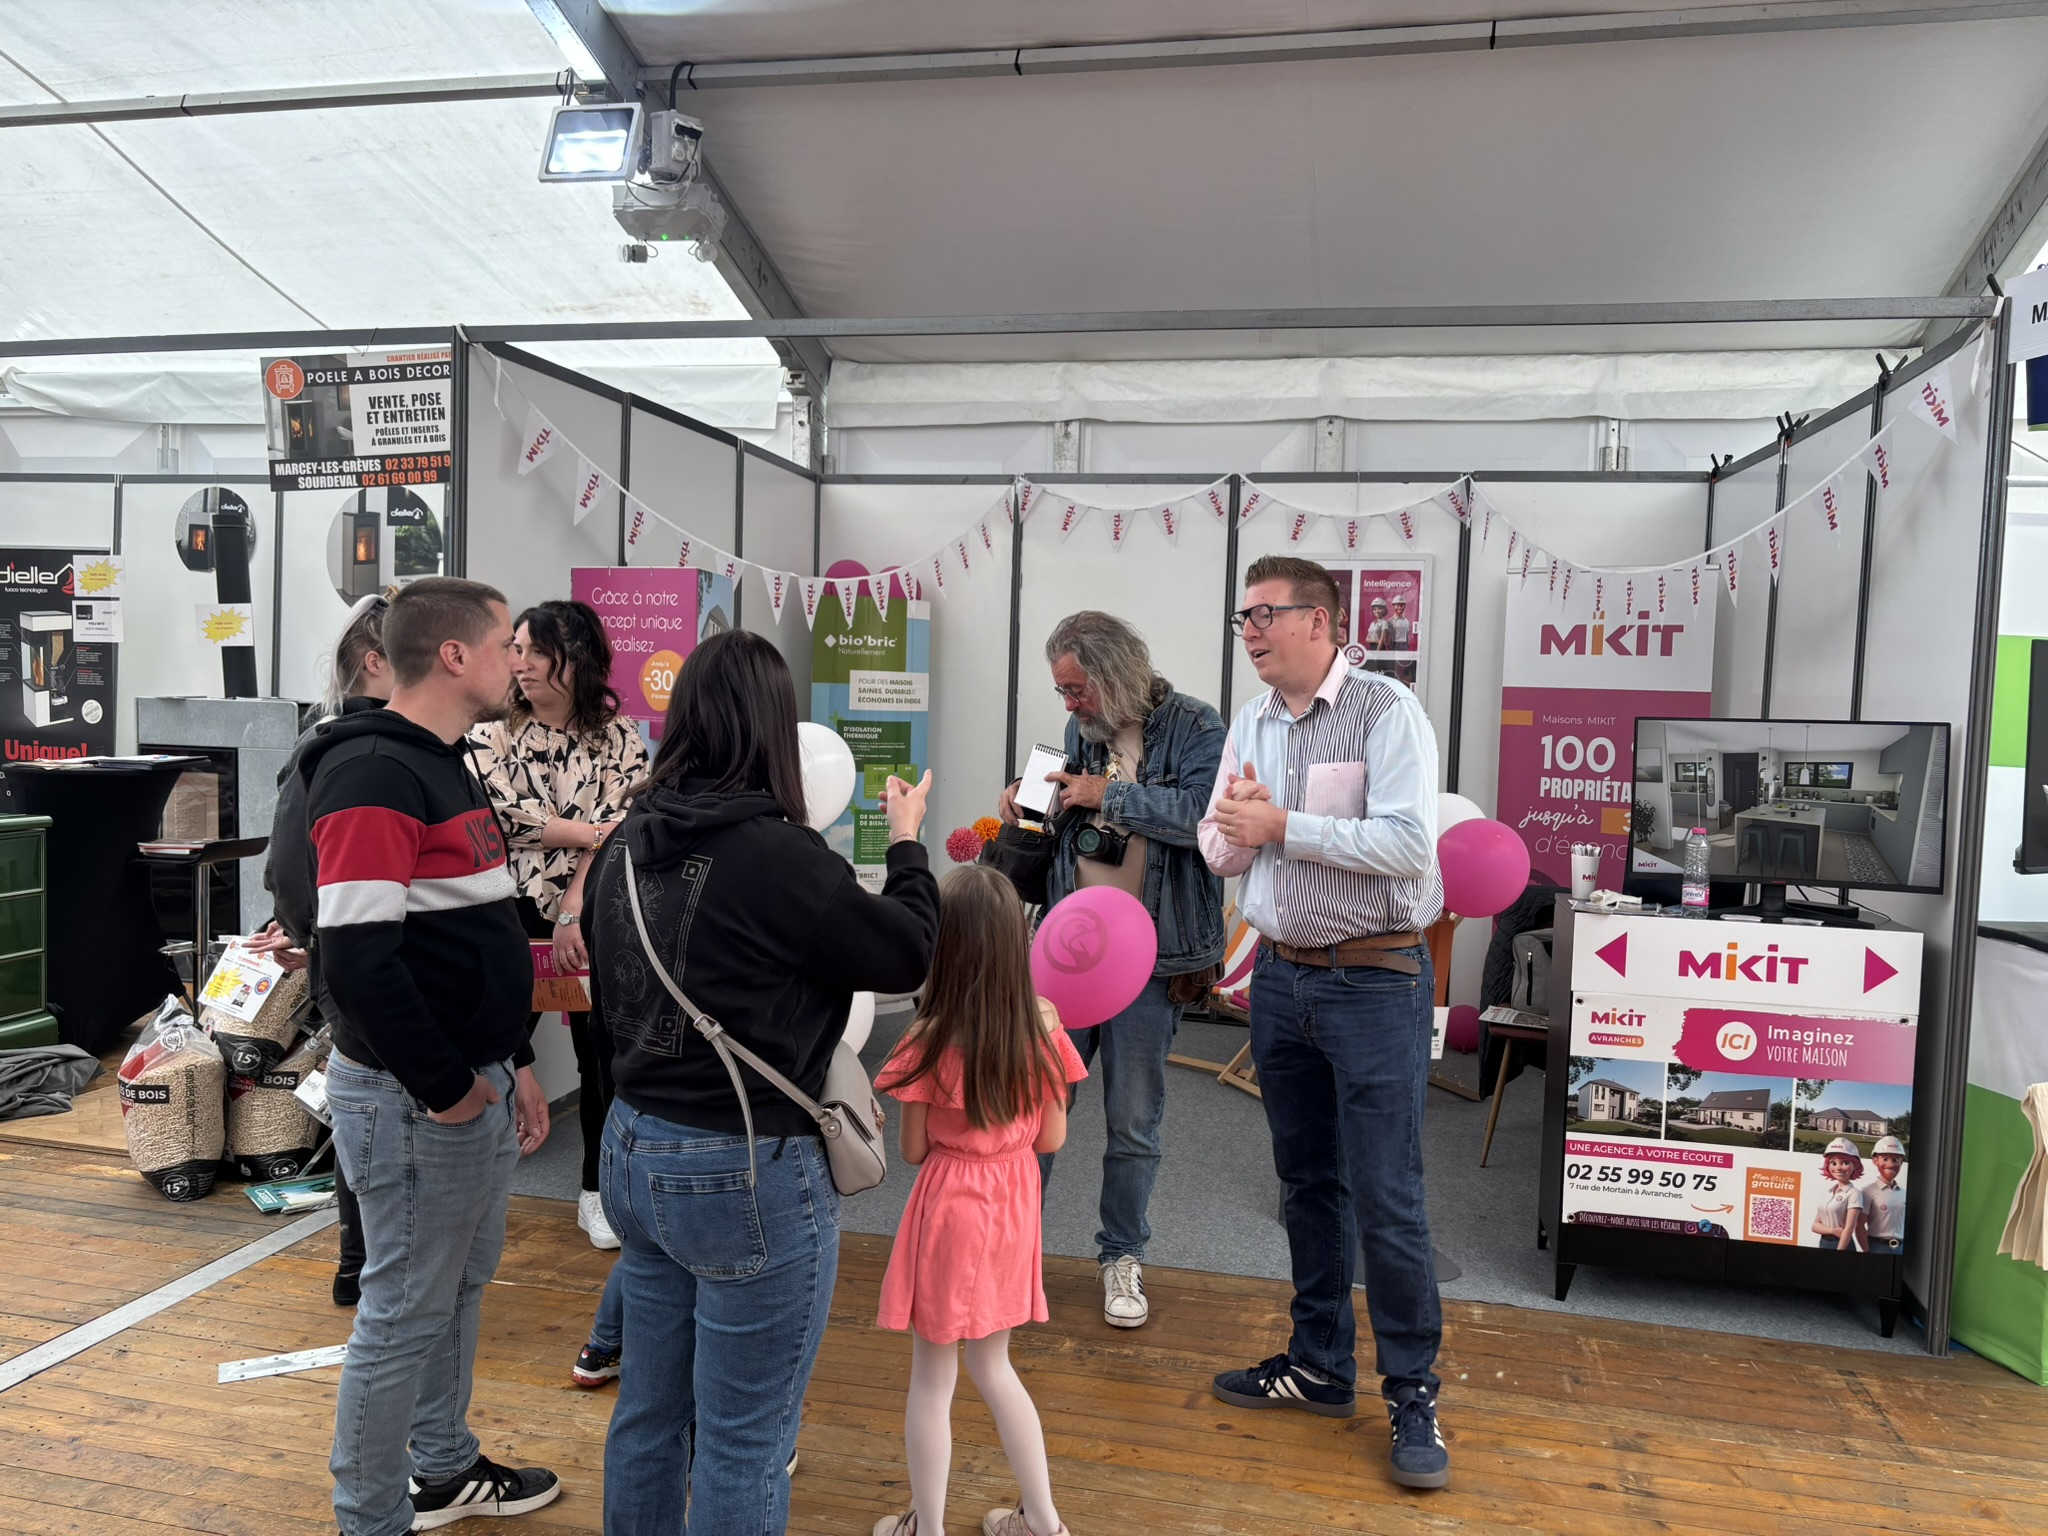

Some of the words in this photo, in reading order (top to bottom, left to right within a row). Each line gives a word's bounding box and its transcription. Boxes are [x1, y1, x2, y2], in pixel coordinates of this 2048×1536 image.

[386, 353, 416, 363] CHANTIER
[416, 350, 440, 360] RÉALISÉ
[306, 370, 348, 385] POELE
[354, 369, 364, 382] A
[369, 366, 401, 381] BOIS
[406, 364, 450, 378] DECOR
[368, 394, 409, 410] VENTE,
[411, 392, 442, 407] POSE
[366, 411, 382, 425] ET
[383, 407, 446, 424] ENTRETIEN
[401, 426, 409, 435] ET
[410, 424, 440, 435] INSERTS
[371, 436, 377, 446] À
[377, 435, 413, 446] GRANULÉS
[414, 435, 422, 444] ET
[423, 434, 429, 444] À
[430, 434, 447, 443] BOIS
[275, 458, 381, 476] MARCEY-LES-GRÈVES
[385, 457, 399, 471] 02
[400, 456, 415, 470] 33
[415, 455, 429, 469] 79
[430, 455, 442, 468] 51
[298, 474, 358, 489] SOURDEVAL
[361, 473, 376, 486] 02
[377, 472, 390, 486] 61
[391, 471, 406, 485] 69
[407, 470, 422, 484] 00
[423, 470, 438, 483] 99
[1363, 579, 1412, 589] Intelligence
[591, 587, 629, 606] Grâce
[633, 590, 642, 606] à
[646, 590, 679, 606] notre
[640, 614, 683, 633] unique
[839, 634, 896, 647] bio'bric
[838, 648, 886, 656] Naturellement
[858, 687, 883, 695] SAINES,
[1542, 714, 1583, 726] Maisons
[1587, 716, 1616, 726] MIKIT
[5, 739, 88, 761] Unique!
[1541, 734, 1616, 773] 100
[1519, 804, 1594, 831] jusqu'à
[1591, 1034, 1642, 1045] AVRANCHES
[1721, 1032, 1751, 1050] ICI
[1768, 1024, 1854, 1047] Imaginez
[1766, 1045, 1798, 1063] VOTRE
[1801, 1047, 1848, 1067] MAISON
[263, 1075, 295, 1086] BOIS
[125, 1089, 136, 1099] DE
[138, 1090, 167, 1100] BOIS
[1569, 1142, 1591, 1152] UNE
[1593, 1144, 1634, 1156] AGENCE
[1636, 1145, 1644, 1157] À
[1646, 1151, 1680, 1160] VOTRE
[1682, 1151, 1724, 1164] ÉCOUTE
[1567, 1163, 1592, 1180] 02
[1597, 1165, 1623, 1182] 55
[1627, 1168, 1654, 1185] 99
[1659, 1171, 1686, 1188] 50
[1692, 1174, 1718, 1192] 75
[1751, 1181, 1795, 1191] gratuite
[1771, 1174, 1795, 1183] étude
[1591, 1184, 1601, 1192] de
[1602, 1186, 1633, 1195] Mortain
[1634, 1187, 1640, 1195] à
[1641, 1188, 1683, 1199] Avranches
[1579, 1212, 1625, 1226] DÉCOUVREZ-NOUS
[1626, 1218, 1640, 1227] AUSSI
[1641, 1219, 1650, 1228] SUR
[1651, 1220, 1659, 1229] LES
